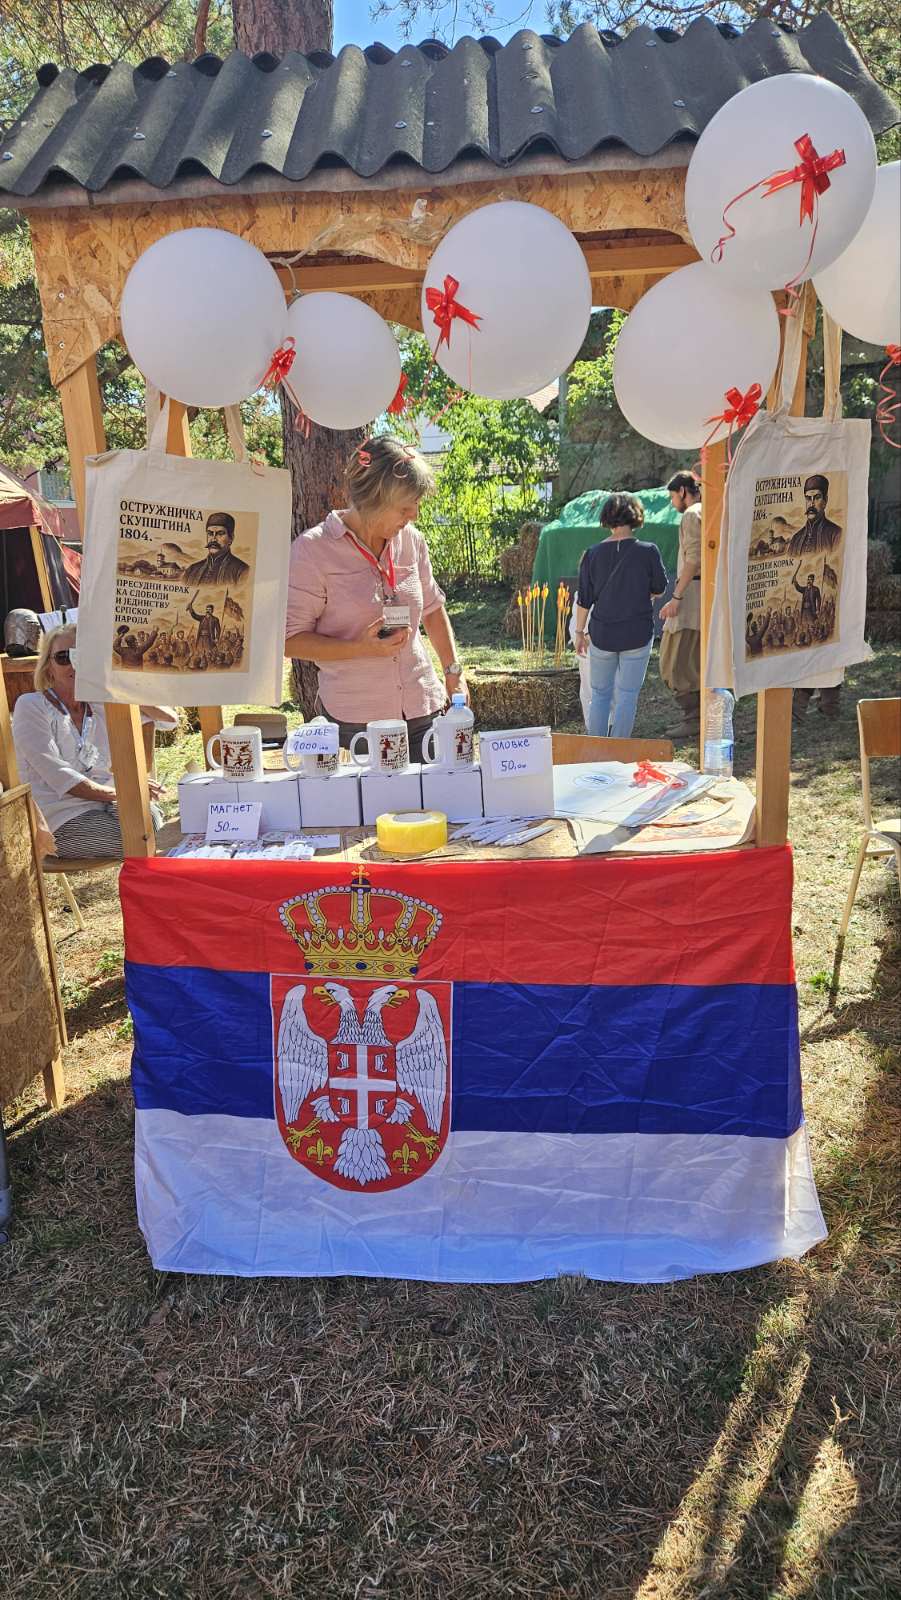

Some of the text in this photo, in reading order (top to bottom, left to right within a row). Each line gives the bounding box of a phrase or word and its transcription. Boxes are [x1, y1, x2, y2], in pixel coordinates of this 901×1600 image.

[120, 500, 204, 521] ОСТРУЖНИЧКА
[120, 514, 192, 533] СКУПШТИНА
[120, 527, 153, 541] 1804.
[116, 579, 190, 594] ПРЕСУДНИ КОРАК
[116, 588, 169, 600] КА СЛОБОДИ
[115, 597, 170, 609] И ЈЕДИНСТВУ
[115, 606, 153, 616] СРПСКОГ
[114, 614, 149, 625] НАРОДА
